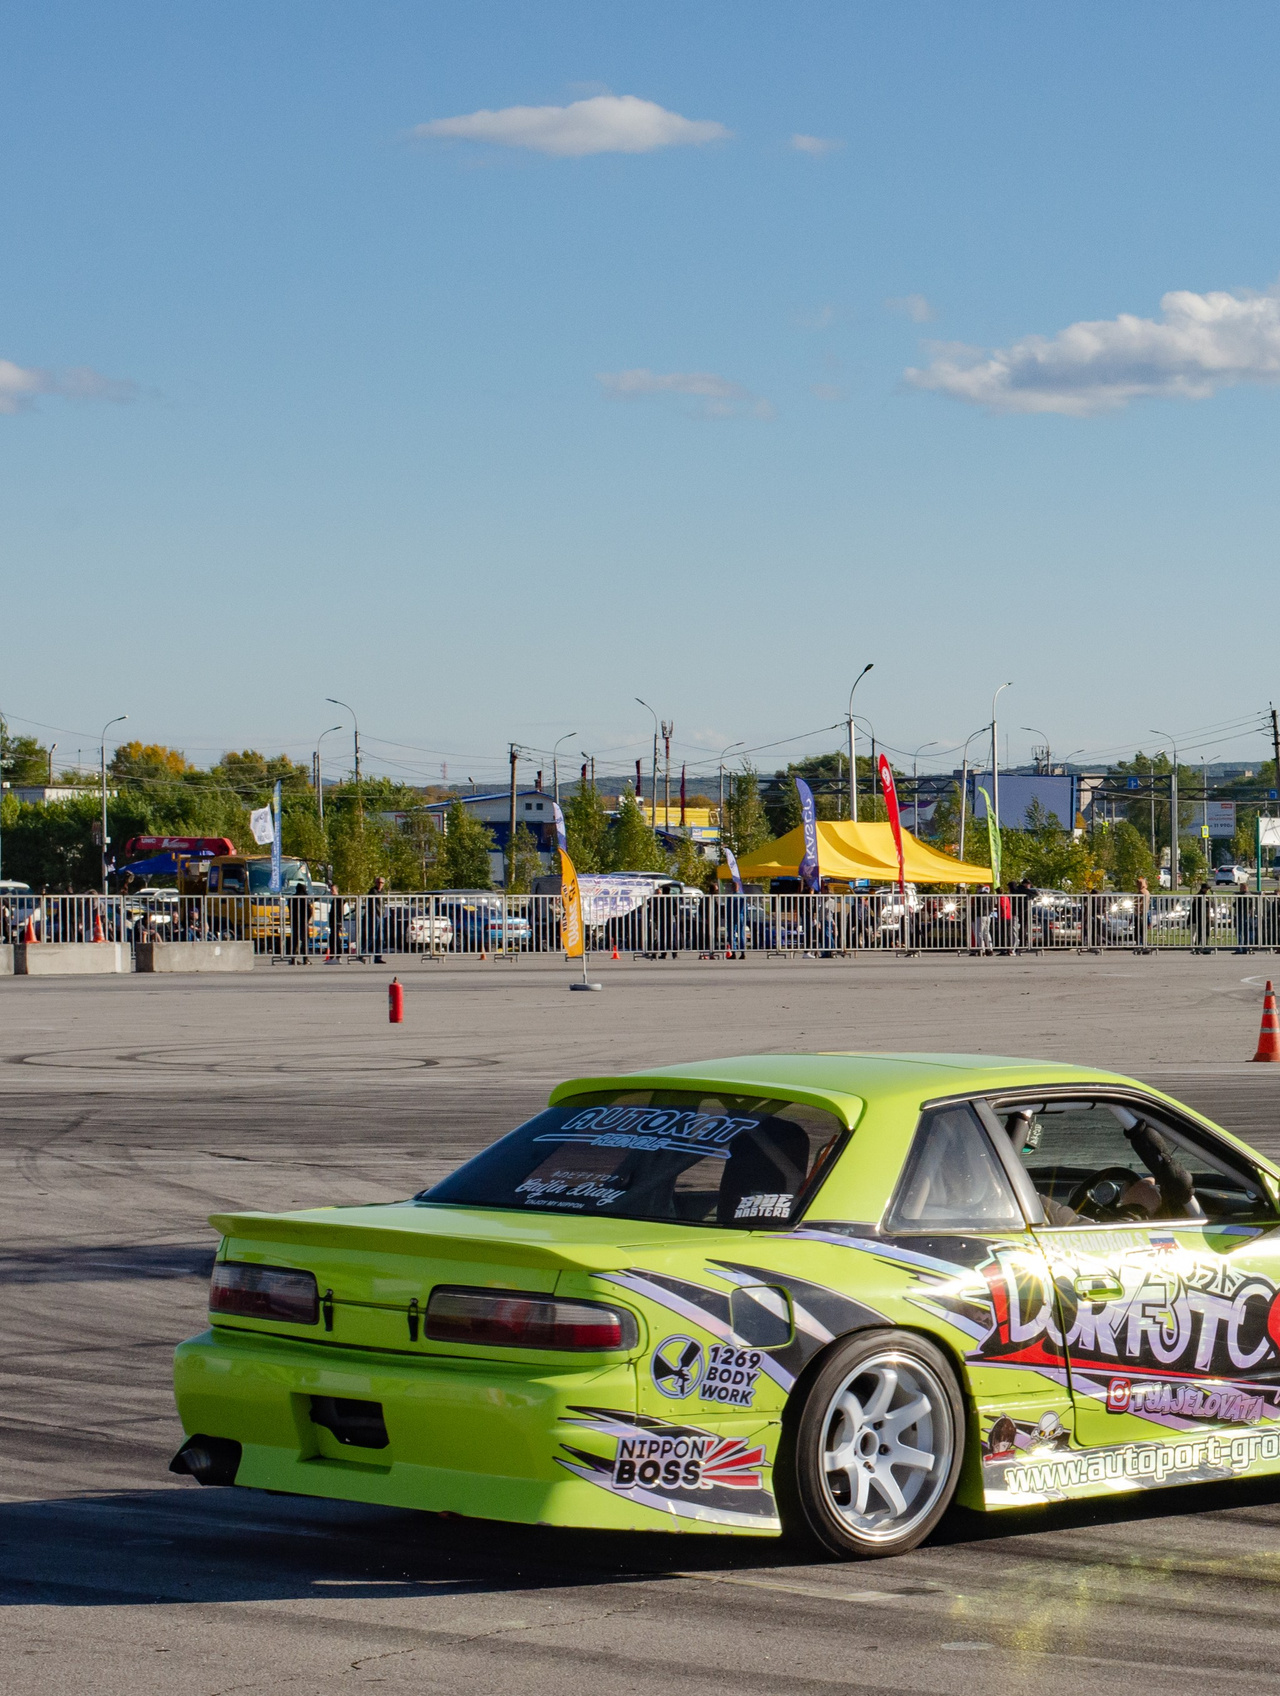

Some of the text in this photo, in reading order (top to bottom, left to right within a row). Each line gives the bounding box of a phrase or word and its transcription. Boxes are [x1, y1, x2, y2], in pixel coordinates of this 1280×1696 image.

[561, 1107, 760, 1143] AUTOKAT
[710, 1345, 762, 1370] 1269
[705, 1366, 759, 1387] BODY
[701, 1383, 754, 1406] WORK
[1131, 1382, 1265, 1424] TYAJELOVATA
[620, 1439, 706, 1459] NIPPON
[615, 1459, 701, 1486] BOSS
